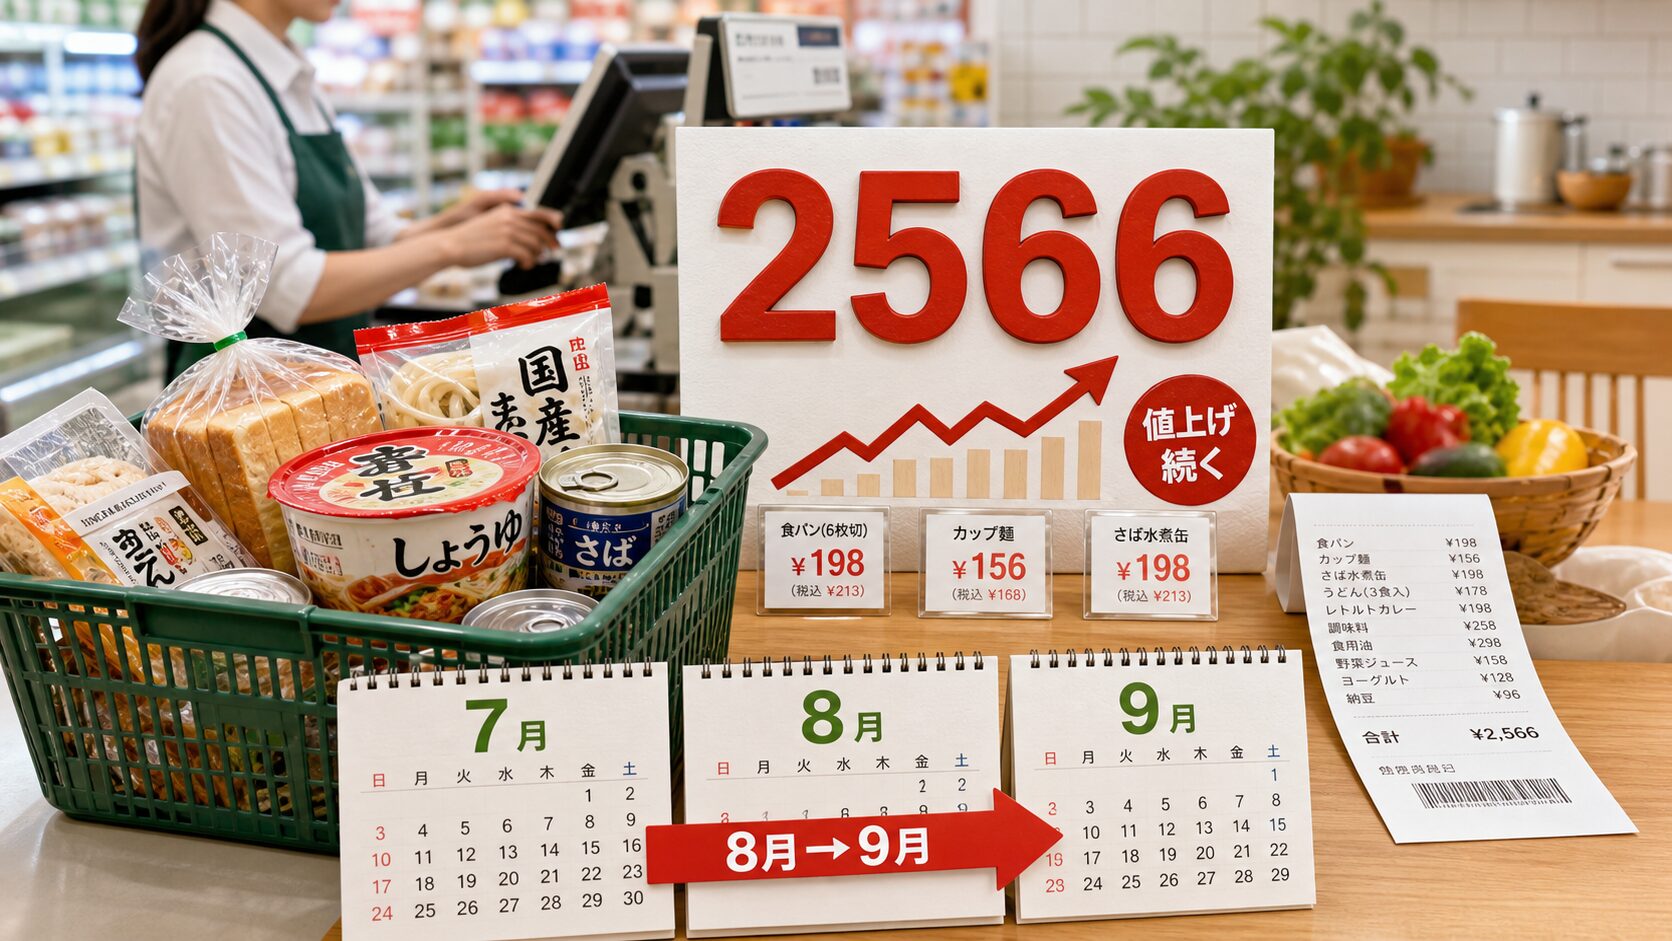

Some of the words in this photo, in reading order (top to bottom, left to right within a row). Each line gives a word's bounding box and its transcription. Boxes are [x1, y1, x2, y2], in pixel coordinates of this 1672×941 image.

[716, 167, 1235, 345] 2566
[518, 345, 580, 452] 国産
[1142, 402, 1237, 443] 値上げ
[1160, 445, 1224, 485] 続く
[781, 523, 867, 538] 食パン(6枚切)
[954, 526, 1014, 541] カップ麺
[1115, 527, 1188, 543] さば水煮缶
[393, 509, 522, 578] しょうゆ
[575, 534, 637, 568] さば
[1317, 538, 1353, 549] 食パン
[1446, 538, 1477, 547] ¥198
[791, 549, 864, 576] ¥198
[953, 552, 1026, 580] ¥156
[1117, 554, 1190, 582] ¥198
[1449, 554, 1480, 563] ¥156
[1322, 570, 1386, 581] さば水煮缶
[1452, 569, 1483, 579] ¥198
[792, 584, 821, 597] (税込
[827, 585, 864, 597] ¥213)
[953, 588, 982, 600] (税込
[988, 589, 1026, 601] ¥168)
[1118, 590, 1148, 602] (税込
[1154, 590, 1191, 603] ¥213)
[1324, 586, 1410, 598] うどん(3食入)
[1455, 586, 1487, 595] ¥178
[1327, 604, 1416, 615] レトルトカレー
[1459, 603, 1491, 613] ¥198
[1328, 622, 1368, 634] 調味料
[1464, 620, 1496, 630] ¥258
[1332, 640, 1373, 651] 食用油
[1468, 638, 1501, 647] ¥298
[1336, 658, 1417, 669] 野菜ジュース
[1474, 655, 1507, 665] ¥158
[1342, 675, 1408, 686] ヨーグルト
[1480, 673, 1514, 682] ¥128
[1346, 693, 1375, 704] 納豆
[1493, 690, 1520, 699] ¥96
[802, 690, 882, 744] 8月
[1120, 682, 1195, 735] 9月
[466, 698, 545, 753] 7月
[1363, 731, 1399, 744] 合計
[1470, 727, 1539, 741] ¥2,566
[718, 762, 729, 775] 日
[758, 760, 769, 774] 月
[798, 759, 810, 772] 火
[837, 757, 850, 771] 水
[876, 756, 889, 770] 木
[915, 755, 928, 768] 金
[955, 753, 968, 767] 土
[1045, 752, 1056, 765] 日
[1083, 751, 1094, 764] 月
[1120, 749, 1132, 763] 火
[1157, 748, 1170, 761] 水
[1194, 747, 1207, 760] 木
[1231, 745, 1243, 759] 金
[1268, 745, 1280, 757] 土
[373, 774, 385, 787] 日
[415, 771, 427, 785] 月
[457, 769, 471, 783] 火
[499, 767, 513, 781] 水
[540, 765, 554, 779] 木
[581, 763, 595, 777] 金
[623, 762, 637, 775] 土
[958, 778, 966, 791] 2
[1272, 768, 1276, 781] 1
[586, 789, 590, 802] 1
[626, 787, 634, 800] 2
[1086, 801, 1094, 814] 3
[1124, 799, 1132, 812] 4
[1162, 798, 1170, 811] 5
[1199, 796, 1207, 809] 6
[1236, 795, 1244, 808] 7
[1272, 793, 1280, 806] 8
[376, 826, 385, 840] 3
[418, 824, 427, 837] 4
[461, 821, 470, 835] 5
[503, 819, 512, 833] 6
[544, 817, 553, 830] 7
[585, 815, 594, 828] 8
[627, 813, 635, 826] 9
[1083, 826, 1100, 839] 10
[1121, 824, 1135, 837] 11
[1159, 823, 1175, 835] 12
[1196, 821, 1213, 834] 13
[1233, 819, 1250, 832] 14
[1270, 818, 1286, 831] 15
[372, 853, 391, 867] 10
[415, 850, 431, 864] 11
[457, 847, 475, 862] 12
[499, 845, 517, 859] 13
[541, 843, 559, 856] 14
[582, 841, 600, 854] 15
[623, 838, 641, 852] 16
[725, 830, 797, 873] 8月
[858, 825, 929, 867] 9月
[1084, 851, 1100, 864] 17
[1122, 849, 1139, 863] 18
[1160, 848, 1176, 861] 19
[1197, 846, 1214, 860] 20
[1234, 845, 1249, 858] 21
[1271, 843, 1288, 856] 22
[373, 879, 391, 894] 17
[416, 877, 434, 891] 18
[458, 874, 476, 888] 19
[499, 871, 519, 886] 20
[541, 869, 558, 883] 21
[582, 867, 601, 881] 22
[623, 864, 642, 879] 23
[1084, 877, 1102, 891] 24
[1122, 875, 1141, 889] 25
[1160, 873, 1178, 887] 26
[1198, 871, 1215, 885] 27
[1235, 870, 1253, 883] 28
[1272, 868, 1289, 881] 29
[372, 906, 393, 921] 24
[415, 903, 435, 918] 25
[458, 900, 478, 915] 26
[500, 898, 519, 913] 27
[541, 895, 561, 910] 28
[583, 893, 602, 908] 29
[624, 891, 643, 905] 30
